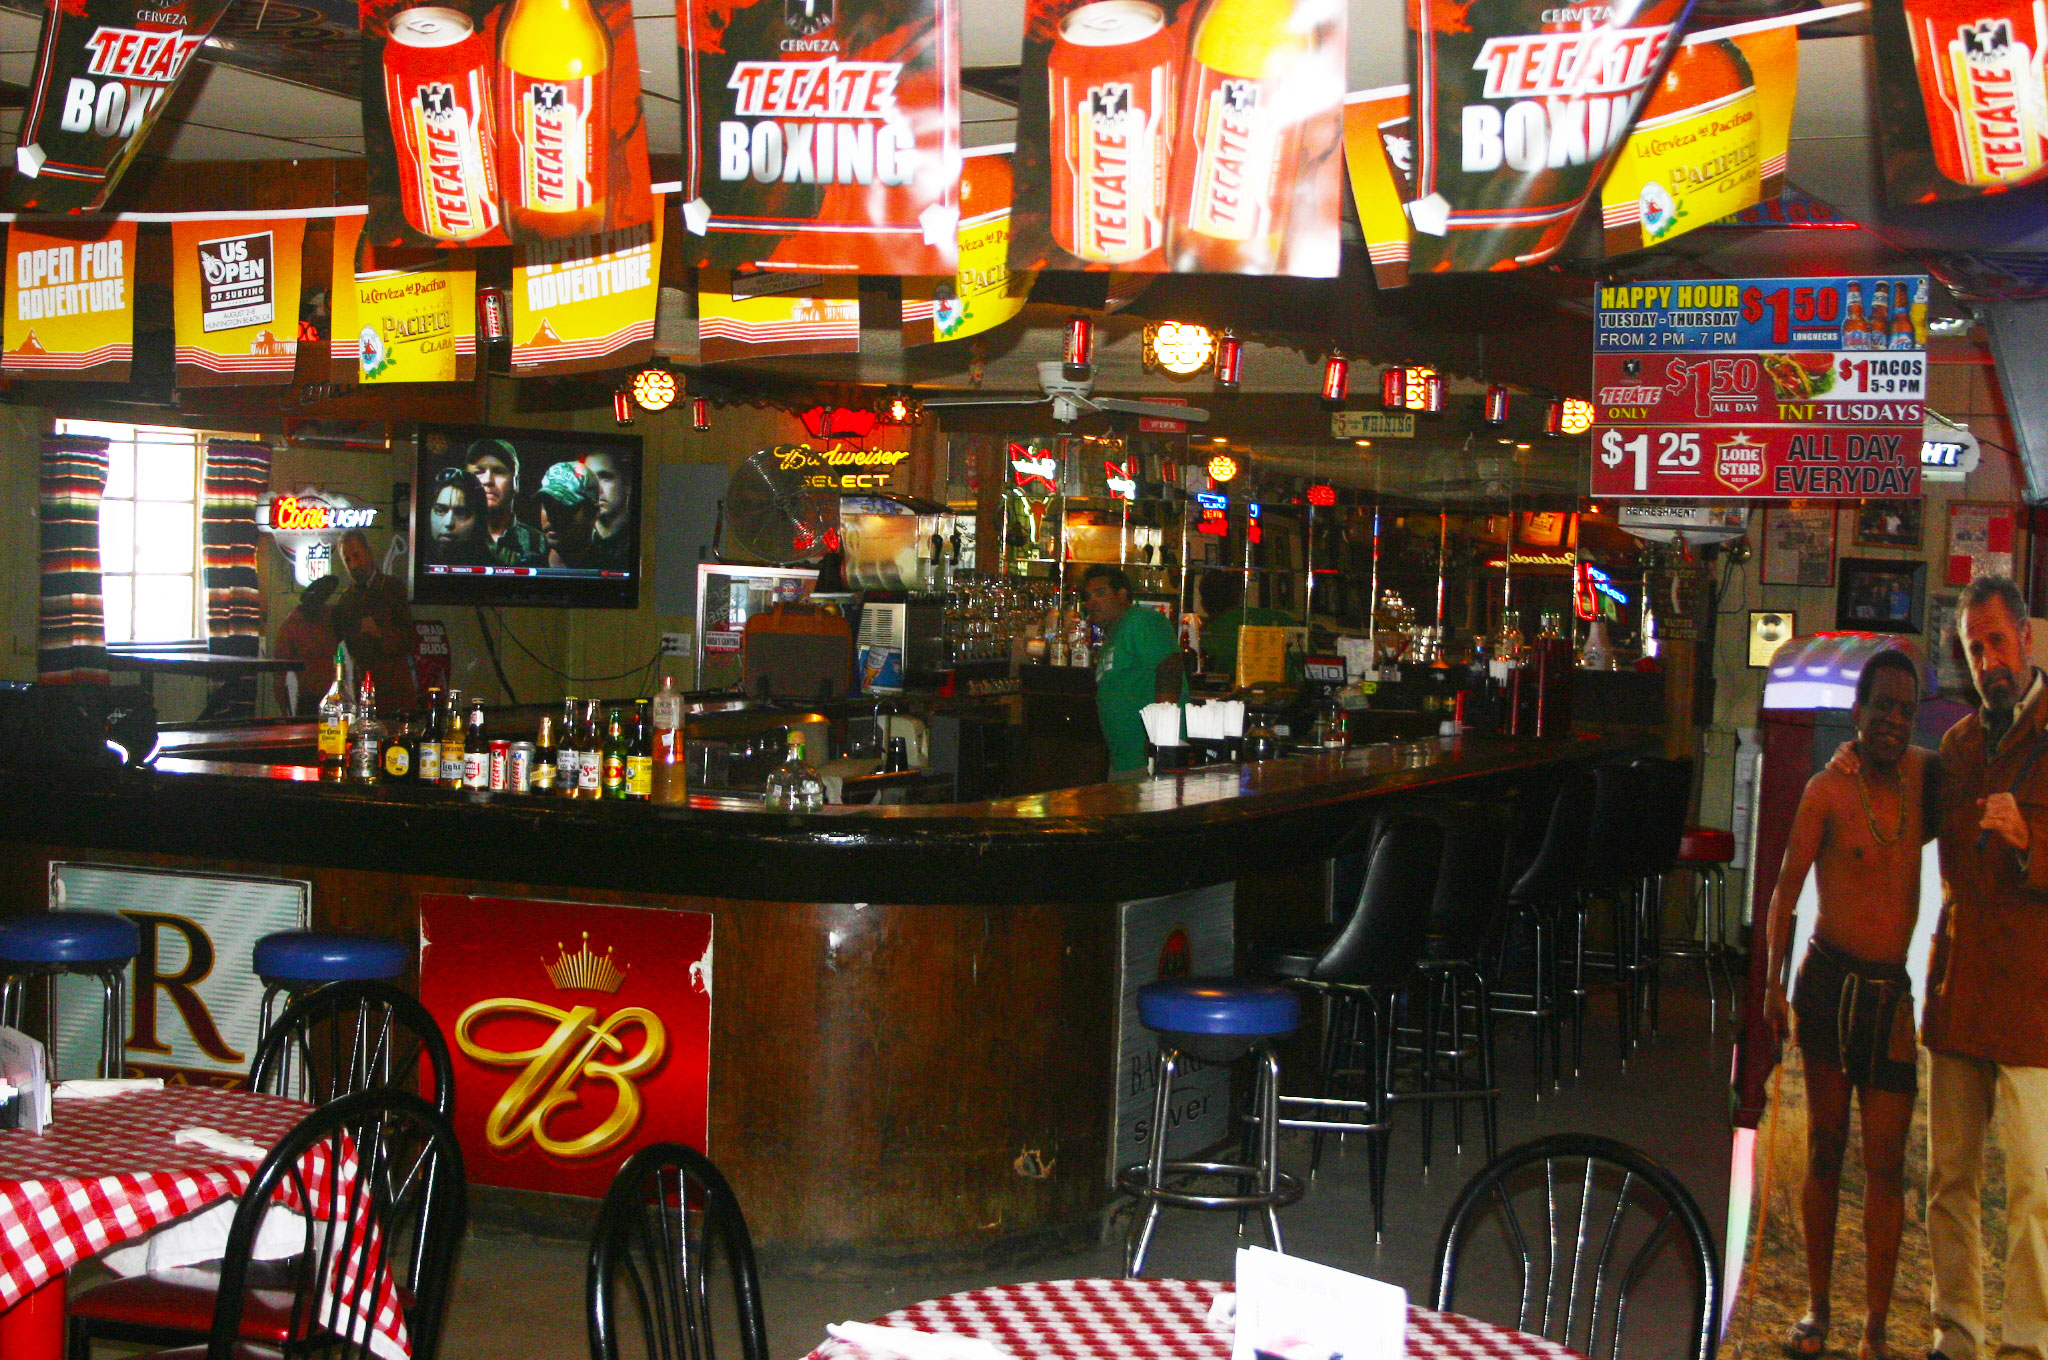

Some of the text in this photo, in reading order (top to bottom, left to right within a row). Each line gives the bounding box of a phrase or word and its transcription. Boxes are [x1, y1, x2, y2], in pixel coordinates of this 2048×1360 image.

[137, 10, 188, 25] CERVEZA
[1541, 7, 1617, 24] CERVEZA
[780, 39, 839, 53] CERVEZA
[727, 55, 904, 118] TECATE
[1969, 66, 2026, 179] TECATE
[720, 121, 916, 187] BOXING
[1651, 134, 1697, 156] Cerveza
[531, 114, 567, 206] TECATE
[1208, 116, 1252, 226] TECATE
[425, 119, 476, 236] TECATE
[1090, 128, 1129, 256] TECATE
[220, 241, 249, 263] US
[18, 240, 124, 288] OPEN FOR
[204, 257, 265, 285] OPEN
[371, 288, 405, 304] Cerveza
[405, 283, 414, 294] del
[527, 253, 651, 312] ADVENTURE
[18, 279, 126, 321] ADVENTURE
[210, 286, 265, 303] OF SURFING
[1601, 284, 1740, 309] HAPPY HOUR
[205, 319, 243, 330] HUNTINGTON
[1599, 311, 1738, 329] TUESDAY THURSDAY
[420, 338, 453, 354] CLARA
[1600, 331, 1737, 347] FROM 2 PM 7 PM
[1792, 332, 1839, 342] LONGNECKS
[1838, 359, 1922, 393] $1 TACOS
[1870, 379, 1921, 393] 5-9 PM
[1599, 385, 1664, 405] TECATE
[1608, 407, 1650, 420] ONLY
[1713, 403, 1759, 413] ALL DAY
[773, 443, 909, 471] Budweiser
[1720, 448, 1760, 462] LONE
[1787, 435, 1905, 467] ALL DAY,
[1719, 462, 1761, 477] STAR
[1774, 466, 1917, 494] EVERYDAY
[801, 474, 889, 488] SELECT
[277, 496, 378, 529] Coors LIGHT
[1626, 507, 1697, 519] REFRESHMENT
[309, 561, 329, 577] NFL
[420, 643, 448, 654] BUDS
[490, 760, 502, 788] TECATE
[119, 909, 245, 1063] R
